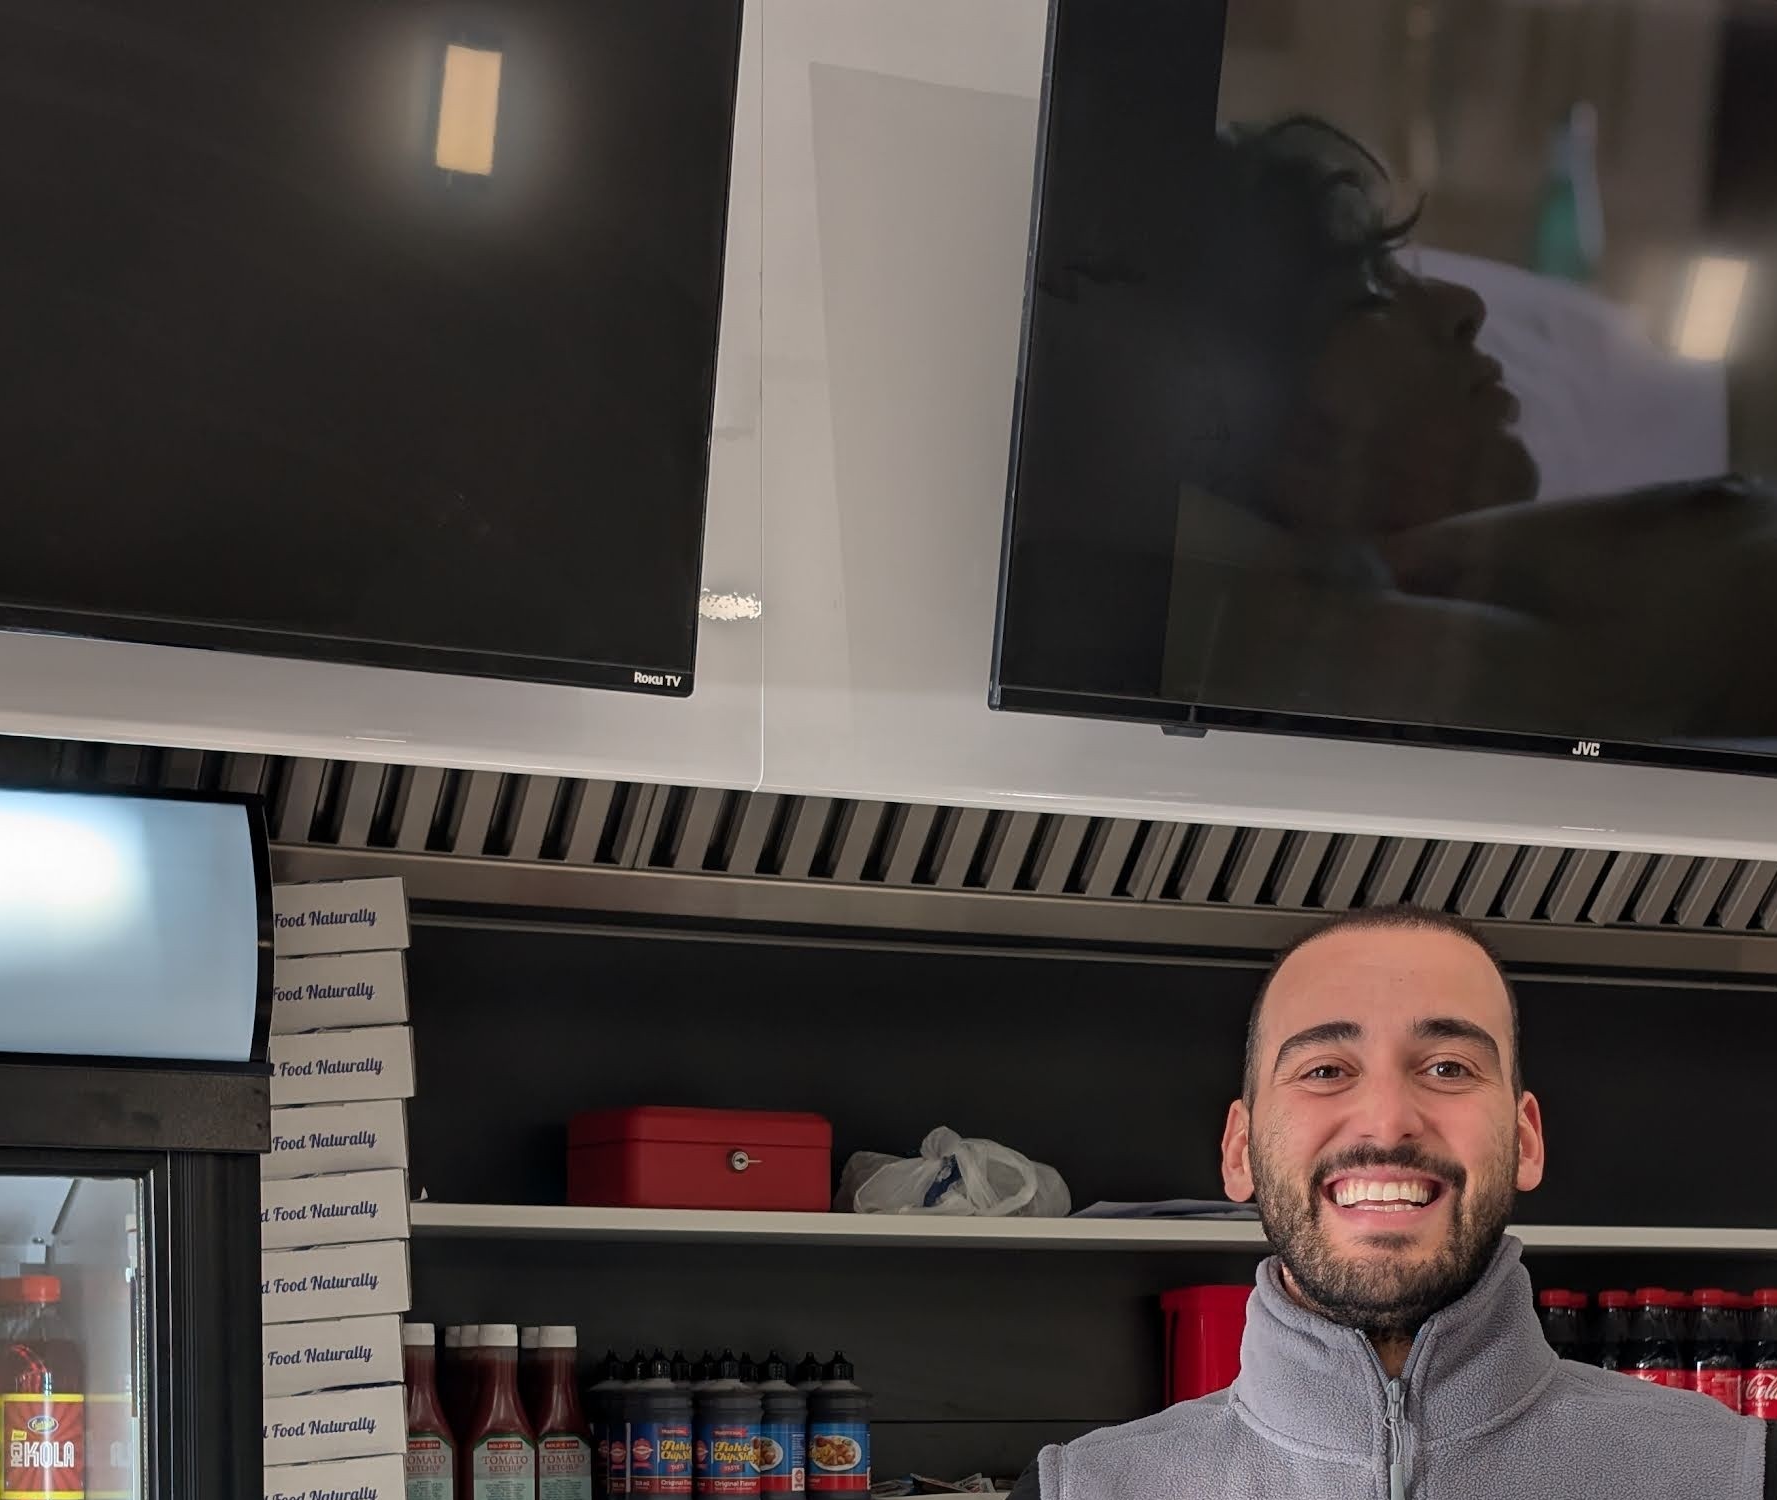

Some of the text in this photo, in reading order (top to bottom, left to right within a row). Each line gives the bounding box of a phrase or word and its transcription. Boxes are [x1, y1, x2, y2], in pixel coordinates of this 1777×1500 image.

[634, 671, 681, 687] Roku TV
[1572, 741, 1600, 756] JVC
[281, 1058, 383, 1077] Food Naturally
[273, 1132, 377, 1151] Food Naturally
[273, 1201, 378, 1222] Food Naturally
[274, 1273, 379, 1294] Food Naturally
[268, 1346, 373, 1366] Food Naturally
[273, 1417, 376, 1438] Food Naturally
[482, 1455, 528, 1465] TOMATO
[540, 1455, 585, 1464] TOMATO
